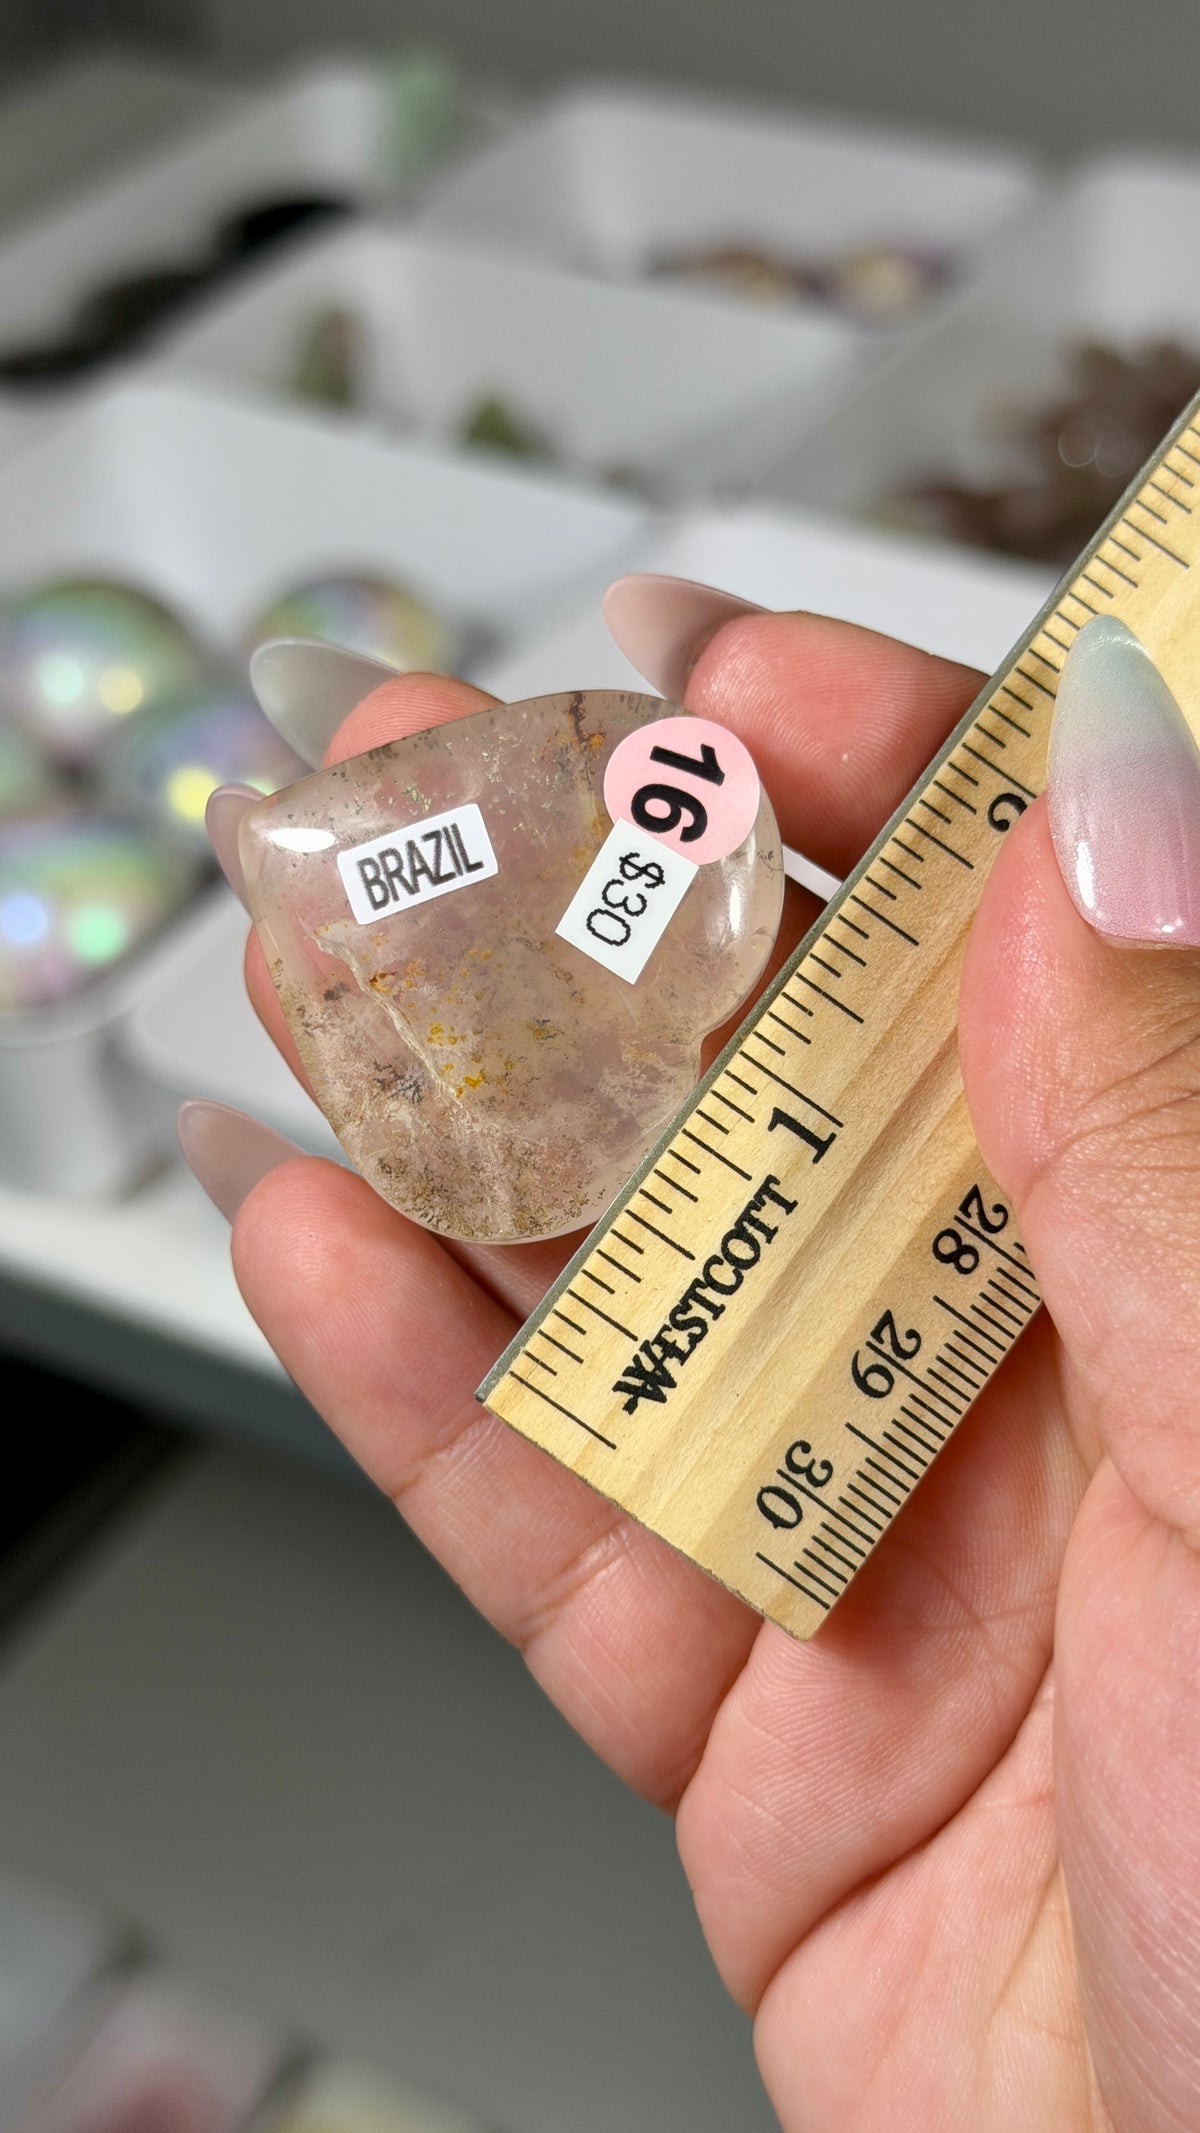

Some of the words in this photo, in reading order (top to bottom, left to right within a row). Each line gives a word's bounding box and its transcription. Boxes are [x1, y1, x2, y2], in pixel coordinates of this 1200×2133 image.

[631, 743, 725, 843] 16
[357, 823, 484, 911] BRAZIL
[586, 851, 666, 947] $30
[767, 1107, 836, 1164] 1
[613, 1174, 798, 1415] WESTCOTT
